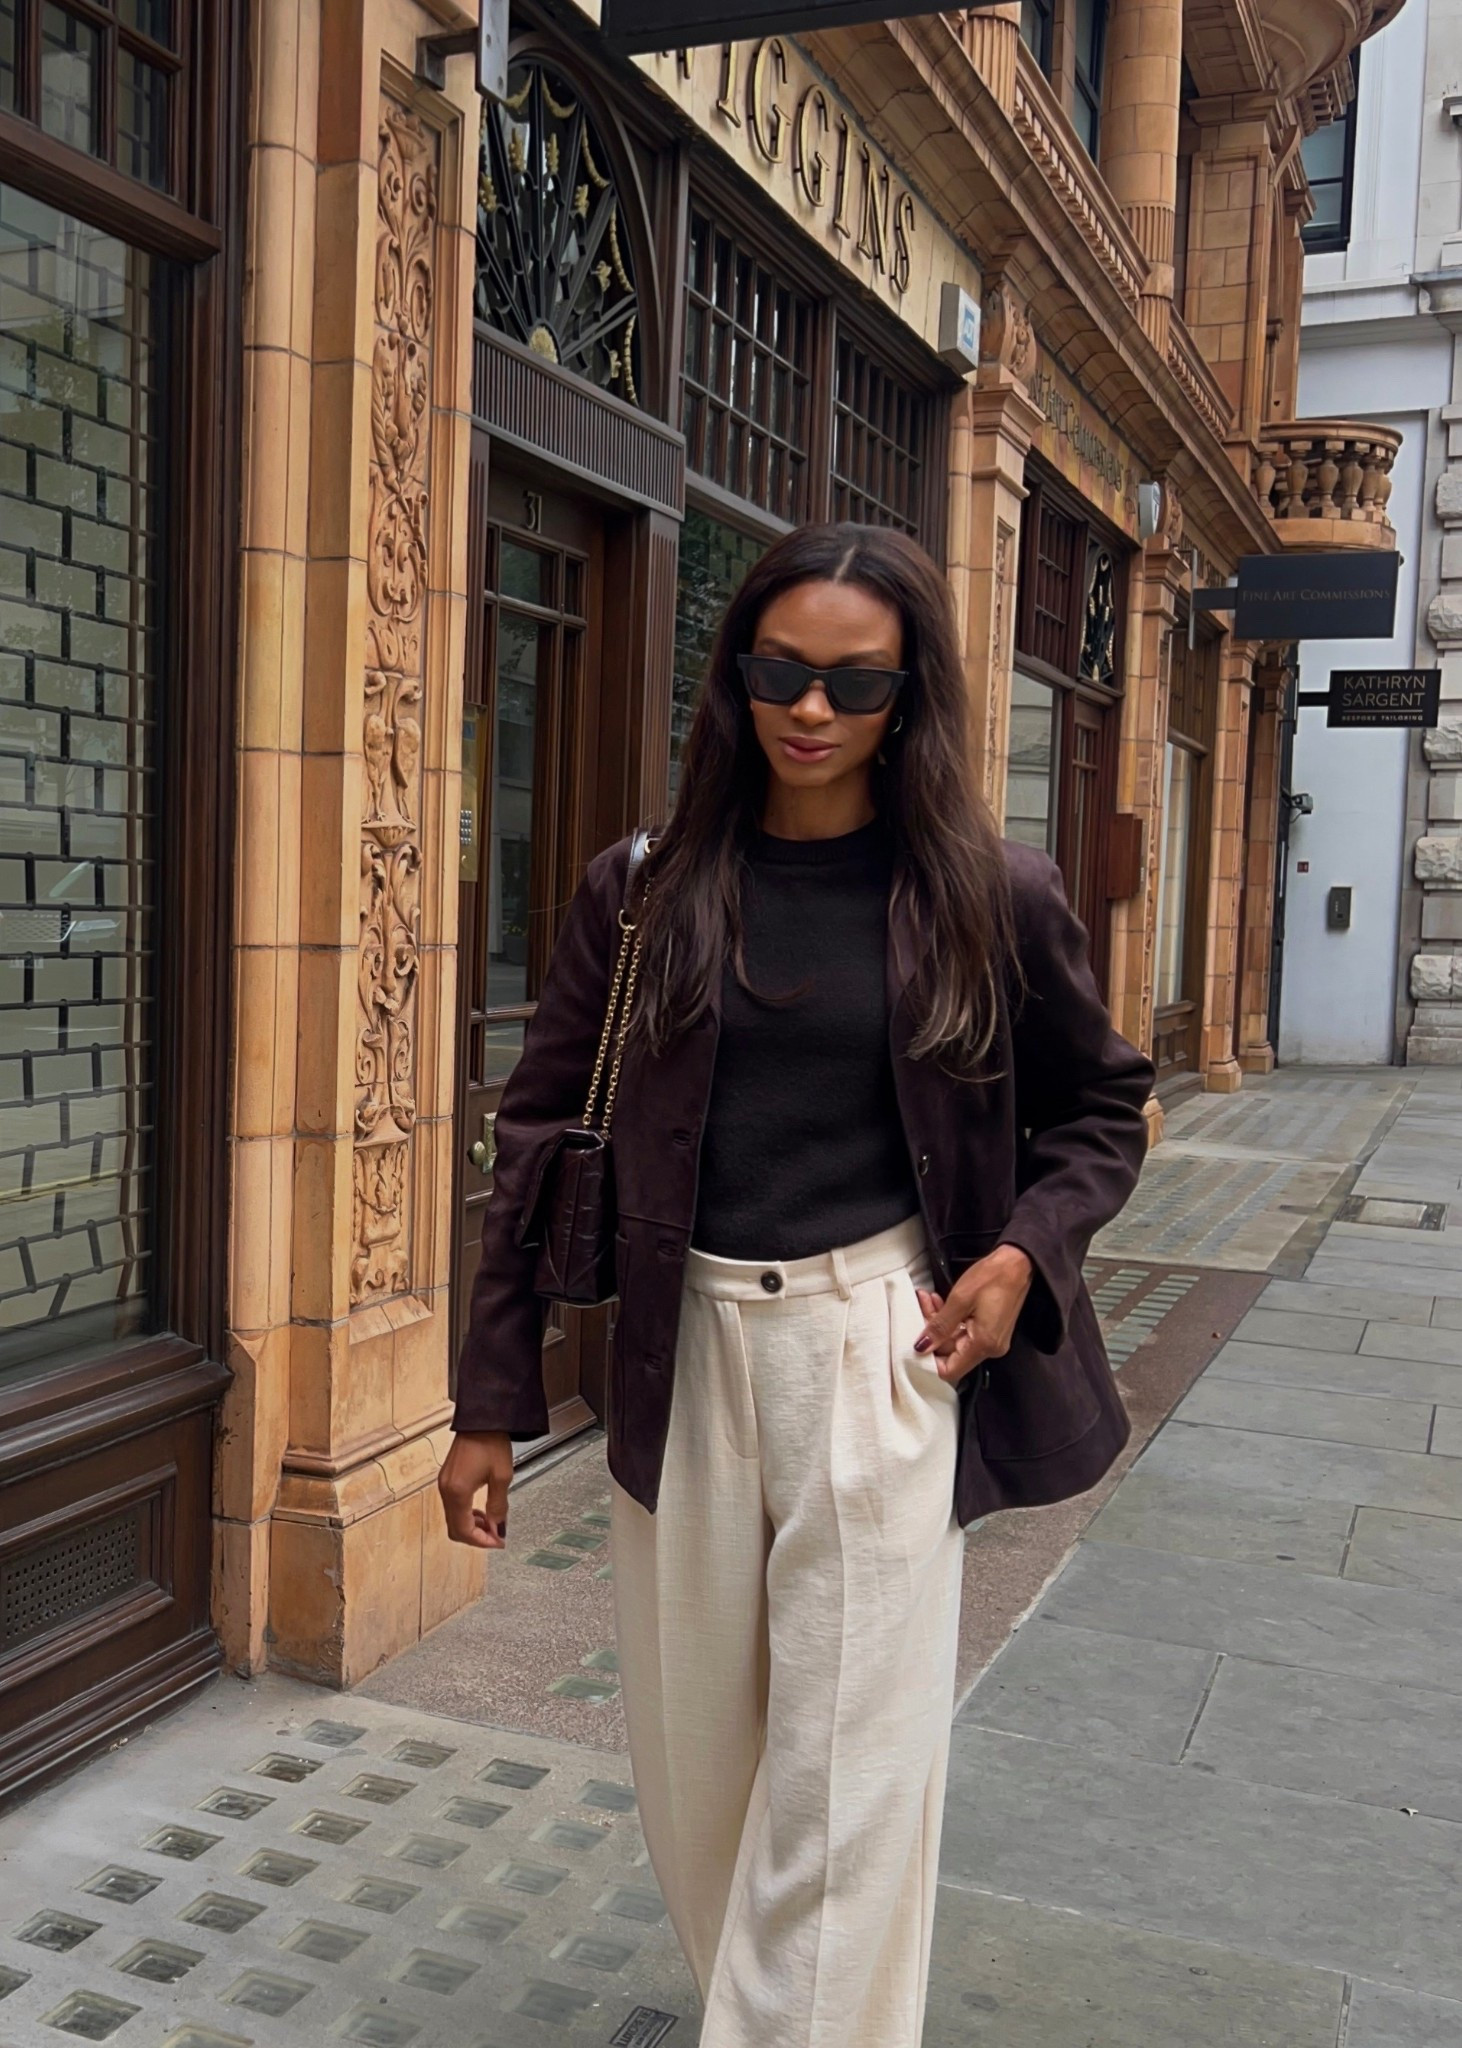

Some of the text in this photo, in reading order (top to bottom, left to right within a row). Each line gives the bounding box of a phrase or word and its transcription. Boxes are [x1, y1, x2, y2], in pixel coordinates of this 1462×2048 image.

[662, 34, 914, 293] IGGINS
[523, 491, 542, 534] 31
[1242, 588, 1390, 602] FINE ART COMMISSIONS
[1343, 675, 1426, 689] KATHRYN
[1342, 692, 1426, 706] SARGENT
